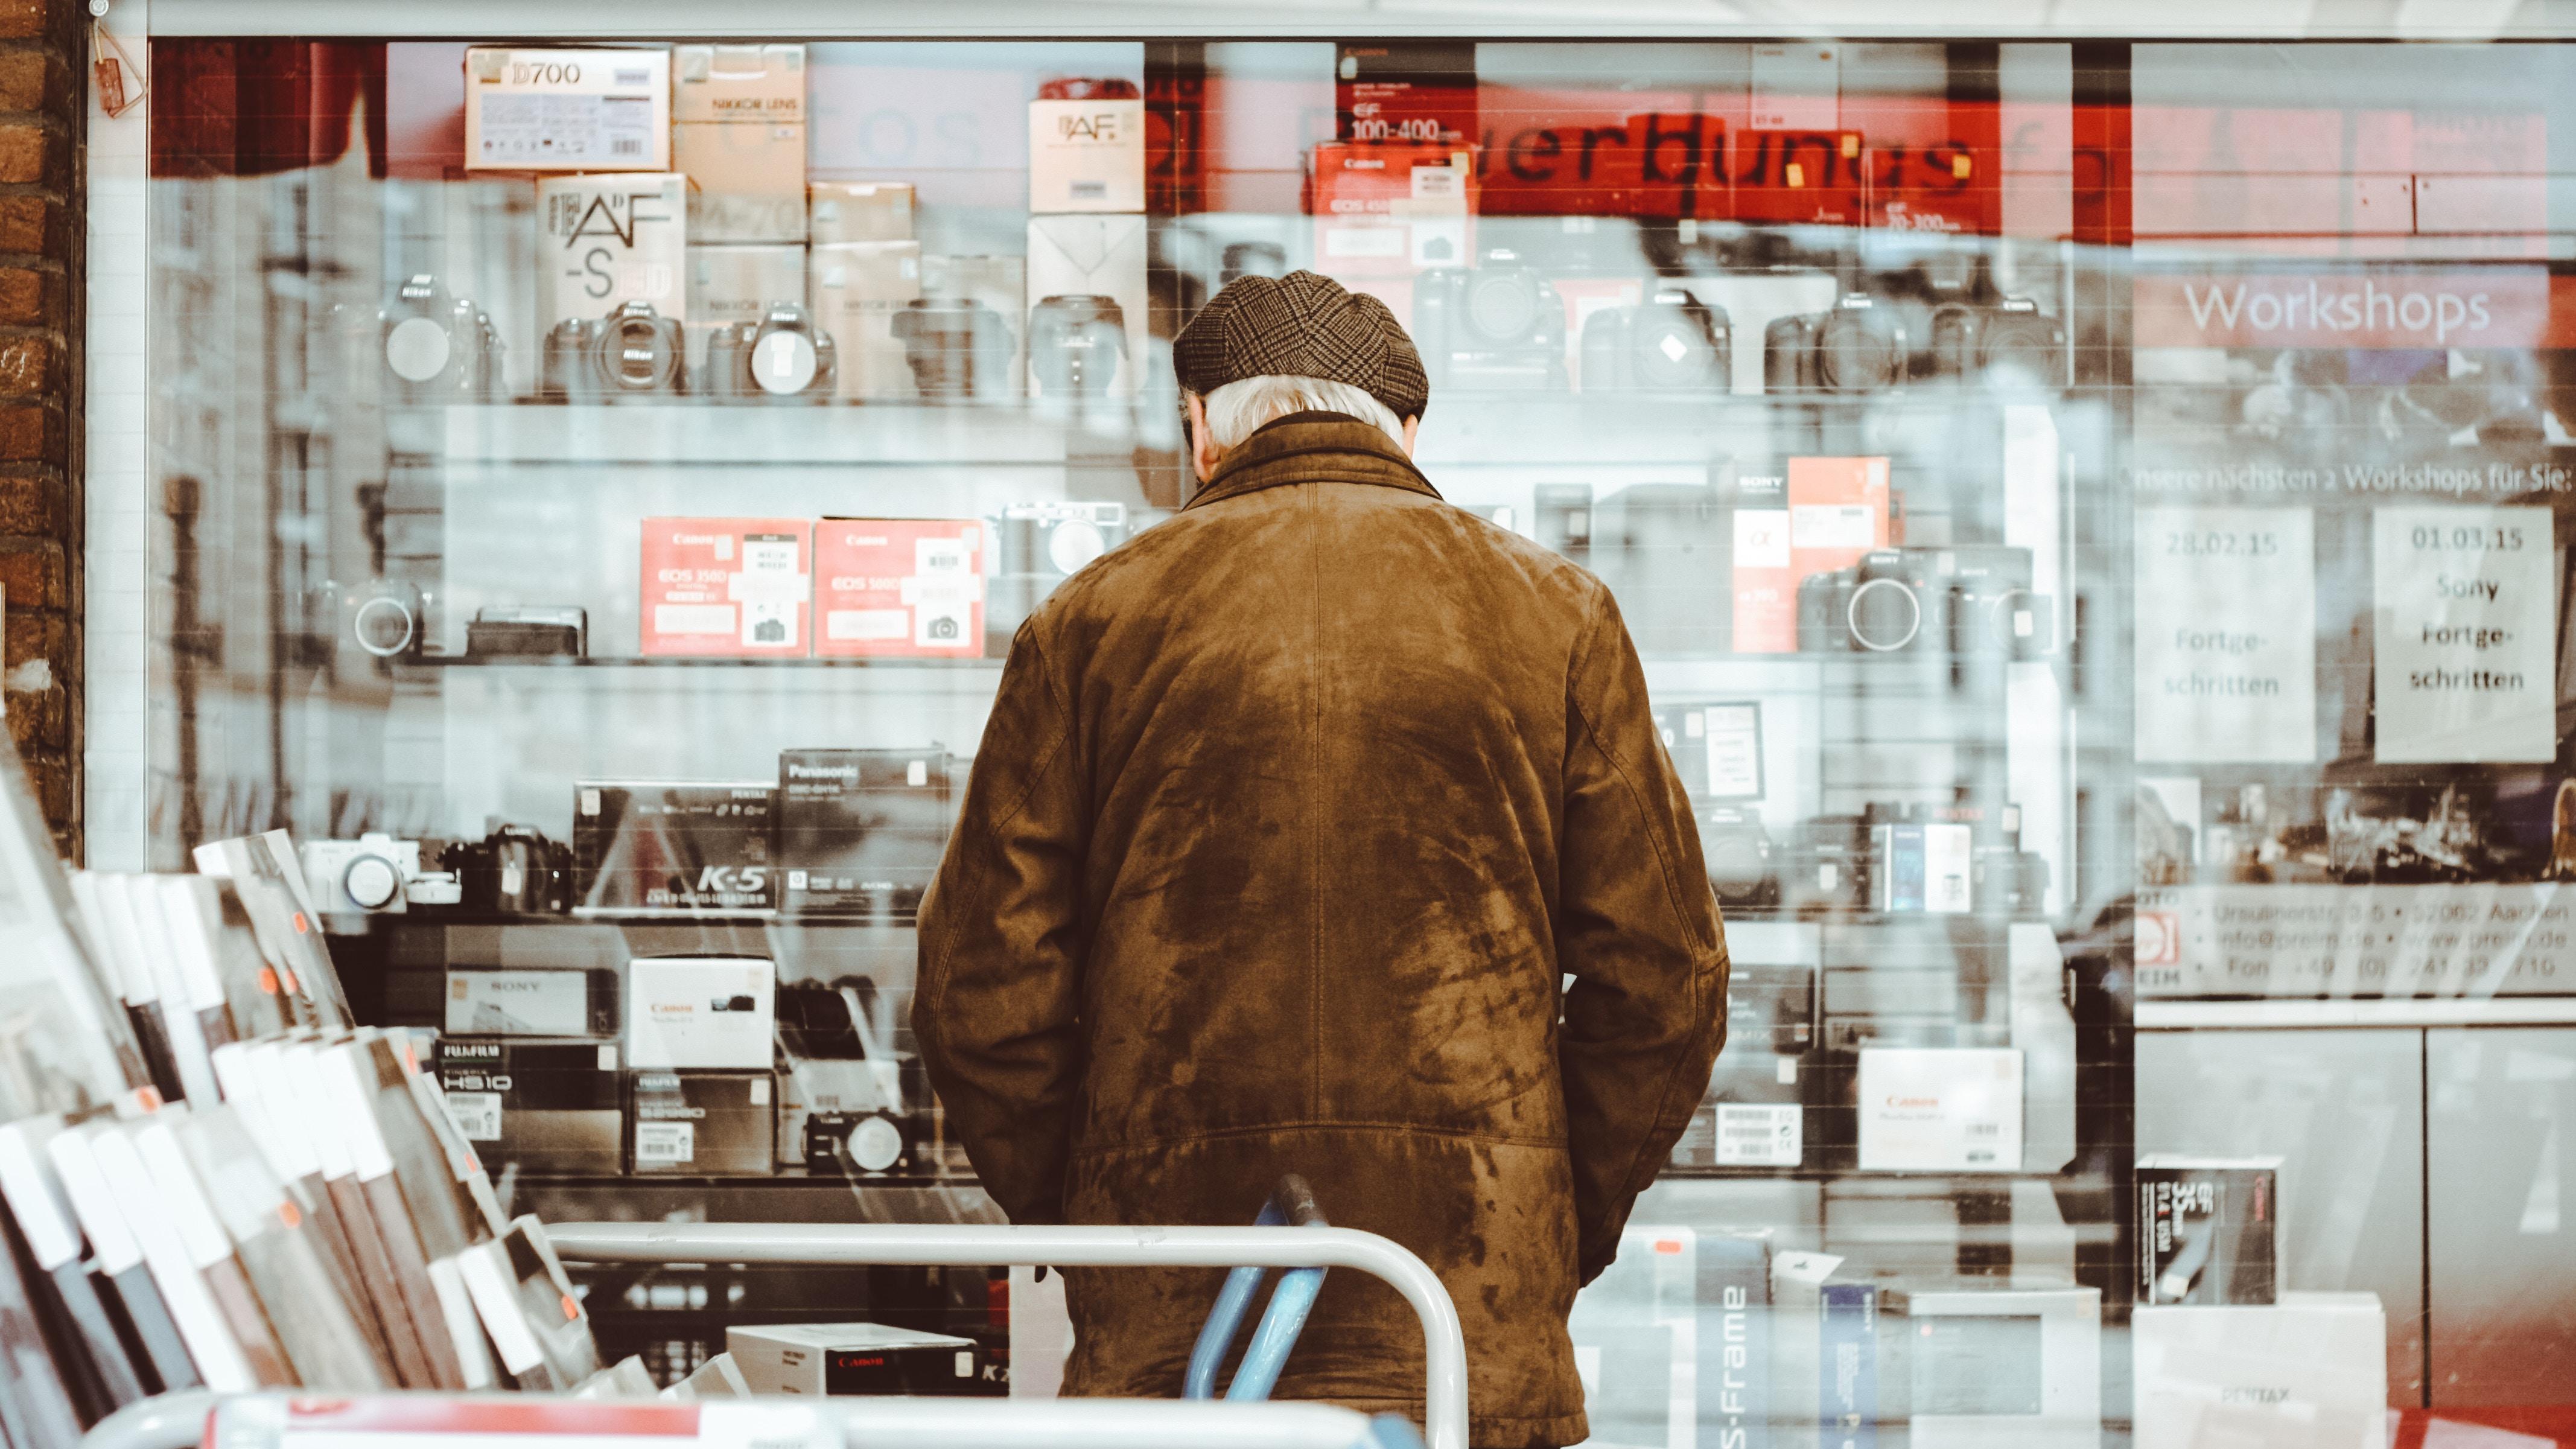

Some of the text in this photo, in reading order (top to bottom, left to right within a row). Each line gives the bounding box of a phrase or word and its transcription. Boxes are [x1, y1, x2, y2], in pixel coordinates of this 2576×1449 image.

[512, 62, 581, 84] D700
[712, 98, 797, 109] NIKKOR LENS
[402, 287, 433, 297] Nikon
[623, 308, 652, 317] Nikon
[771, 311, 798, 322] Nikon
[2184, 279, 2491, 346] Workshops
[623, 348, 654, 360] Nikon
[1738, 476, 1783, 487] SONY
[2134, 468, 2202, 491] nsere
[2343, 462, 2482, 498] Workshops
[2489, 462, 2525, 492] für
[2530, 462, 2572, 492] Sie:
[672, 533, 714, 545] Canon
[845, 535, 888, 546] Canon
[2166, 532, 2277, 556] 28.02.15
[2412, 526, 2524, 550] 01.03.15
[658, 568, 693, 583] EOS
[831, 576, 867, 590] EOS
[2437, 575, 2500, 601] Sony
[2177, 628, 2268, 652] Fortge-
[2422, 623, 2513, 648] Fortge-
[2164, 672, 2279, 696] schritten
[2409, 666, 2524, 691] schritten
[788, 764, 859, 779] Panasonic
[696, 865, 768, 892] K-5
[490, 981, 539, 992] SONY
[650, 1004, 693, 1013] Canon
[444, 1045, 500, 1057] FUJIFILM
[444, 1075, 512, 1091] HS10
[1887, 1095, 1939, 1107] Canon
[2197, 1181, 2213, 1214] EF
[838, 1357, 884, 1368] Canon
[1722, 1285, 1746, 1449] S-Frame
